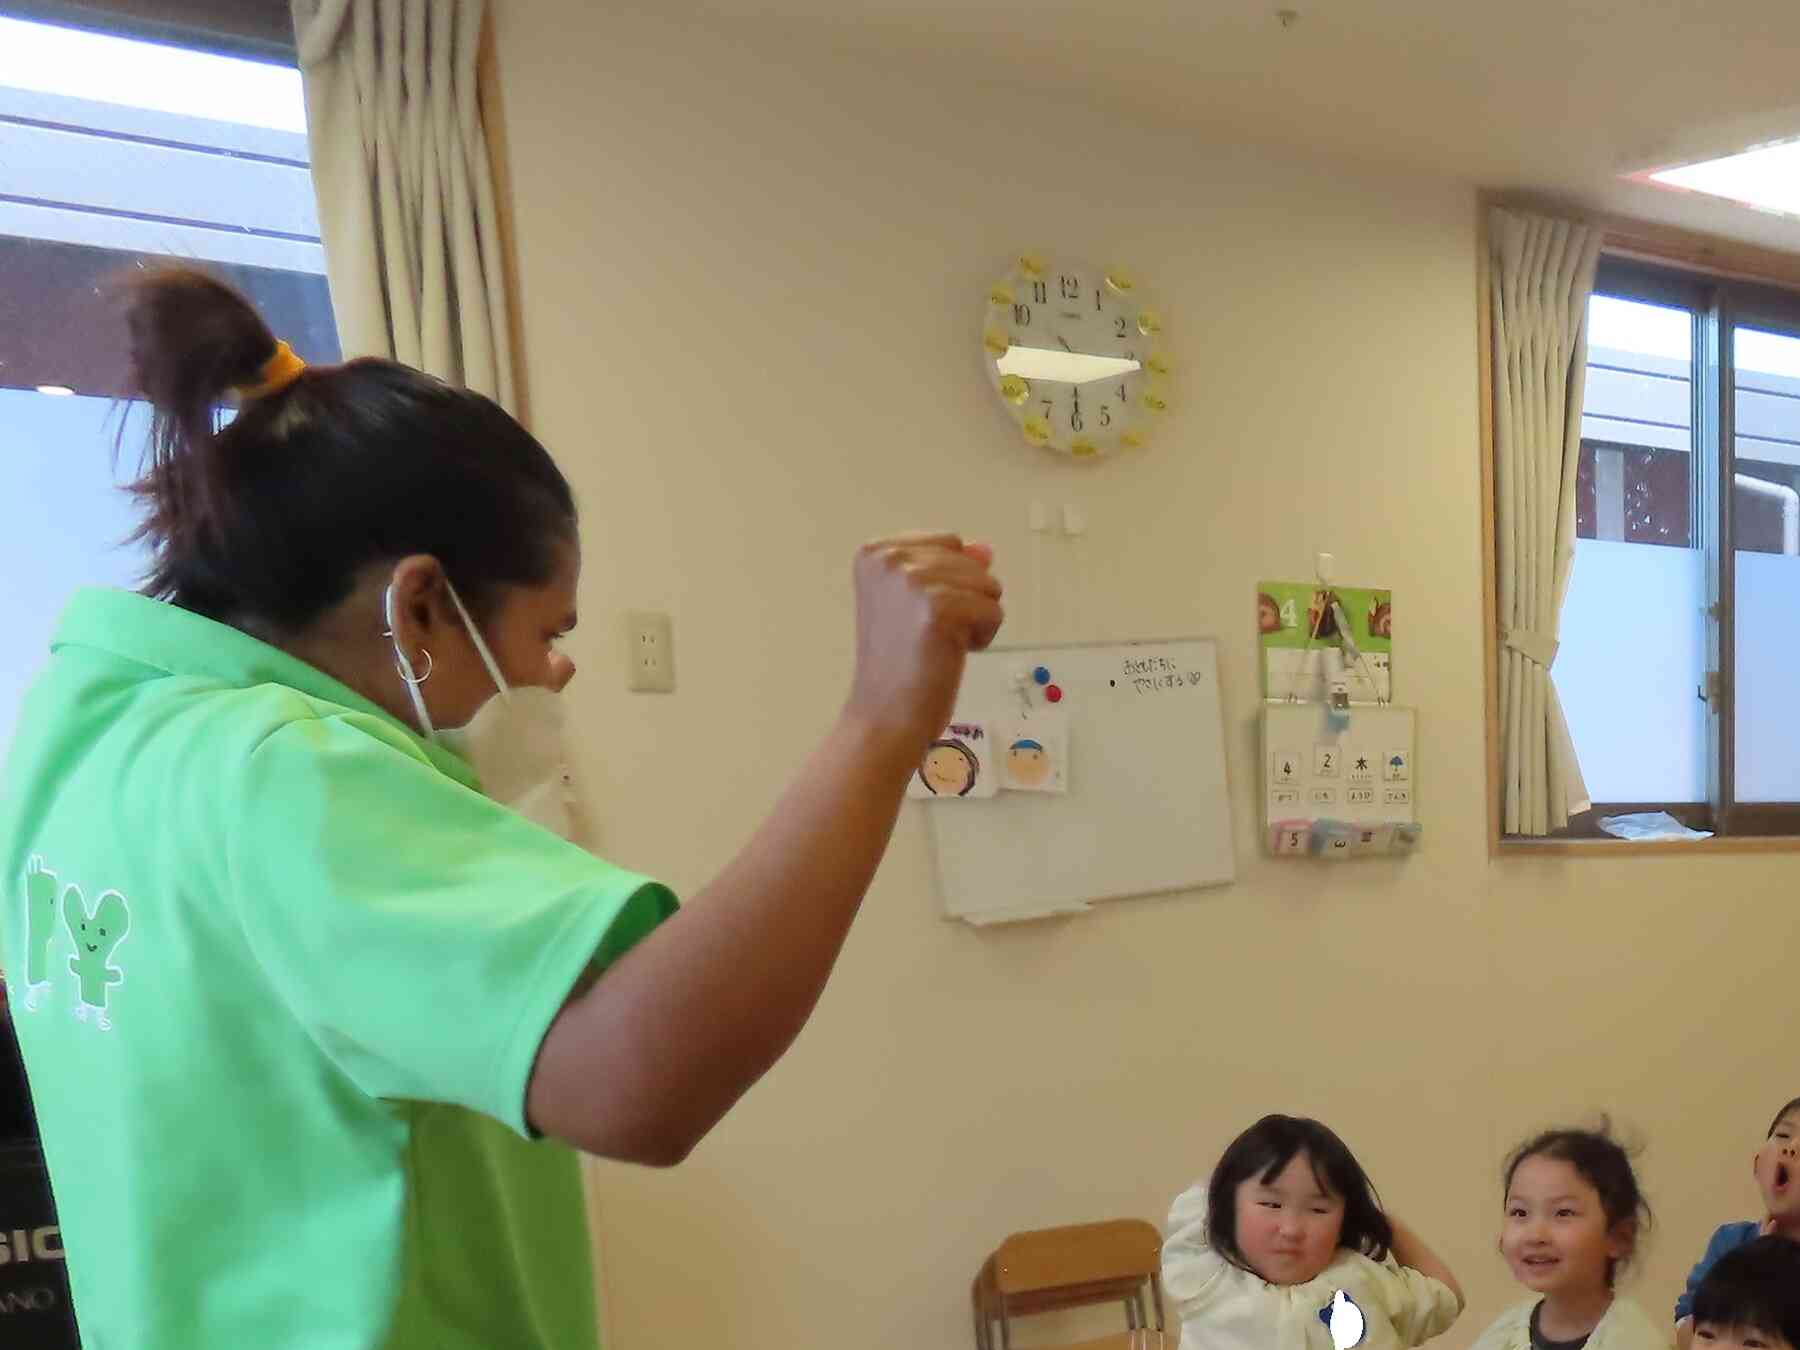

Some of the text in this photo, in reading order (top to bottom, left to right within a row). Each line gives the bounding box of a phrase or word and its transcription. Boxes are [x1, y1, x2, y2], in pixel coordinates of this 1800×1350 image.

[1034, 281, 1048, 305] 11
[1060, 274, 1079, 299] 12
[1095, 288, 1102, 312] 1
[1013, 303, 1032, 327] 10
[1114, 316, 1127, 339] 2
[1115, 383, 1128, 403] 4
[1100, 404, 1112, 427] 5
[1279, 598, 1298, 628] 4
[1283, 762, 1292, 776] 4
[1323, 753, 1332, 769] 2
[1290, 831, 1299, 847] 5
